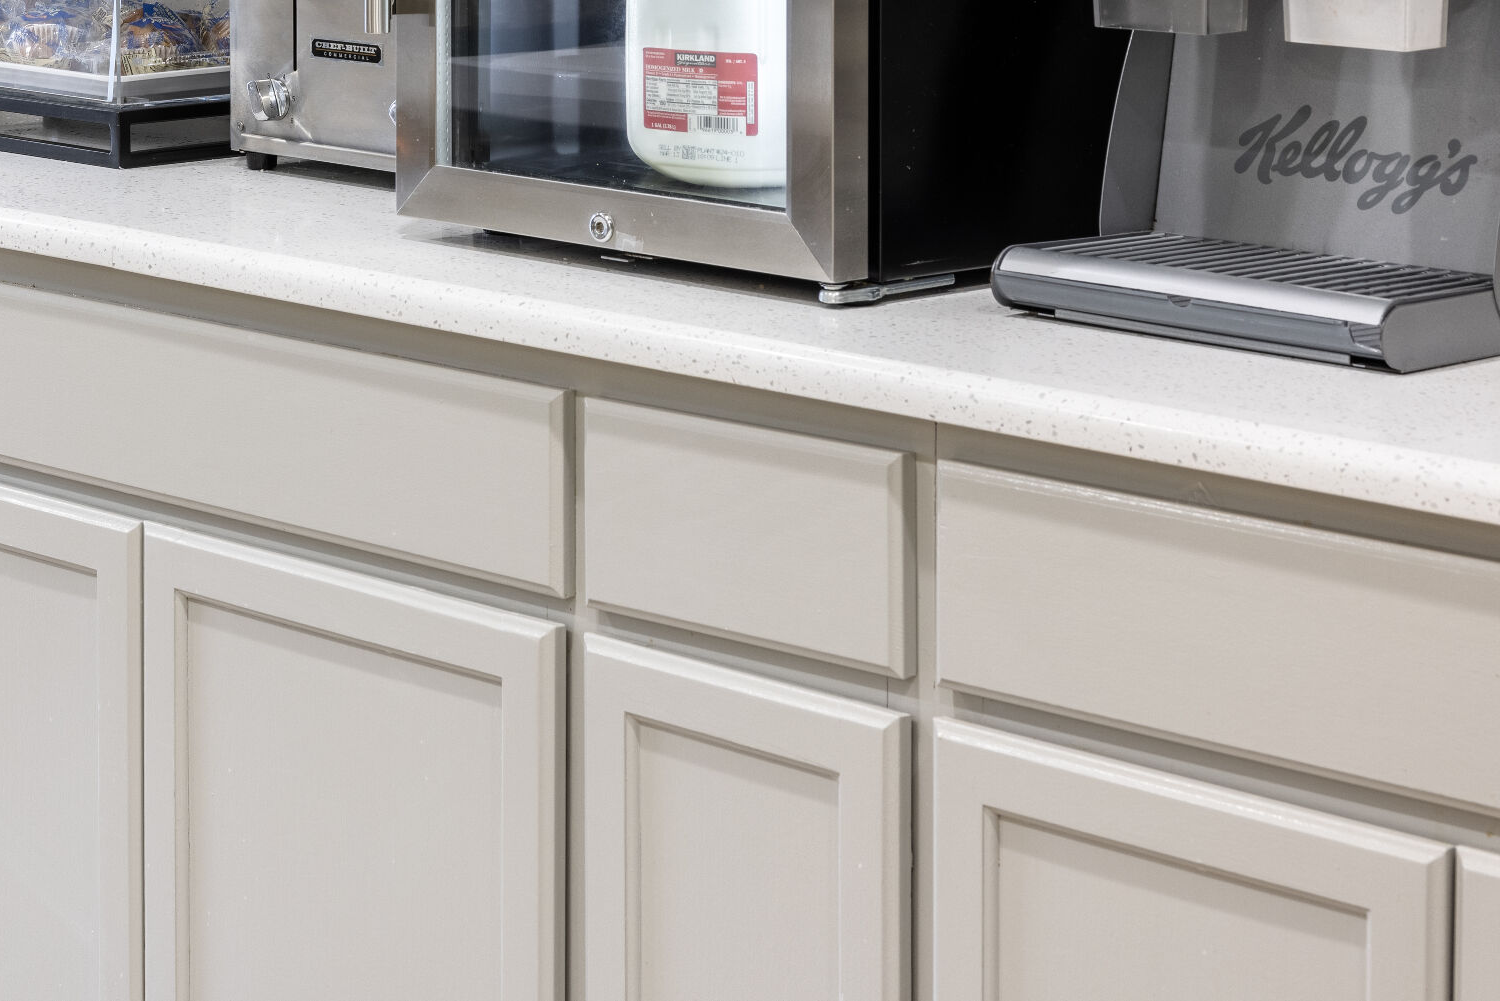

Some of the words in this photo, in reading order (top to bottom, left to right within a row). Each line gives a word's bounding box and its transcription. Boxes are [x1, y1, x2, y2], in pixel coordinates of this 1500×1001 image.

[314, 40, 378, 54] CHEF-BUILT
[323, 51, 371, 61] COMMERCIAL
[676, 52, 716, 63] KIRKLAND
[1234, 104, 1478, 215] Kellogg's
